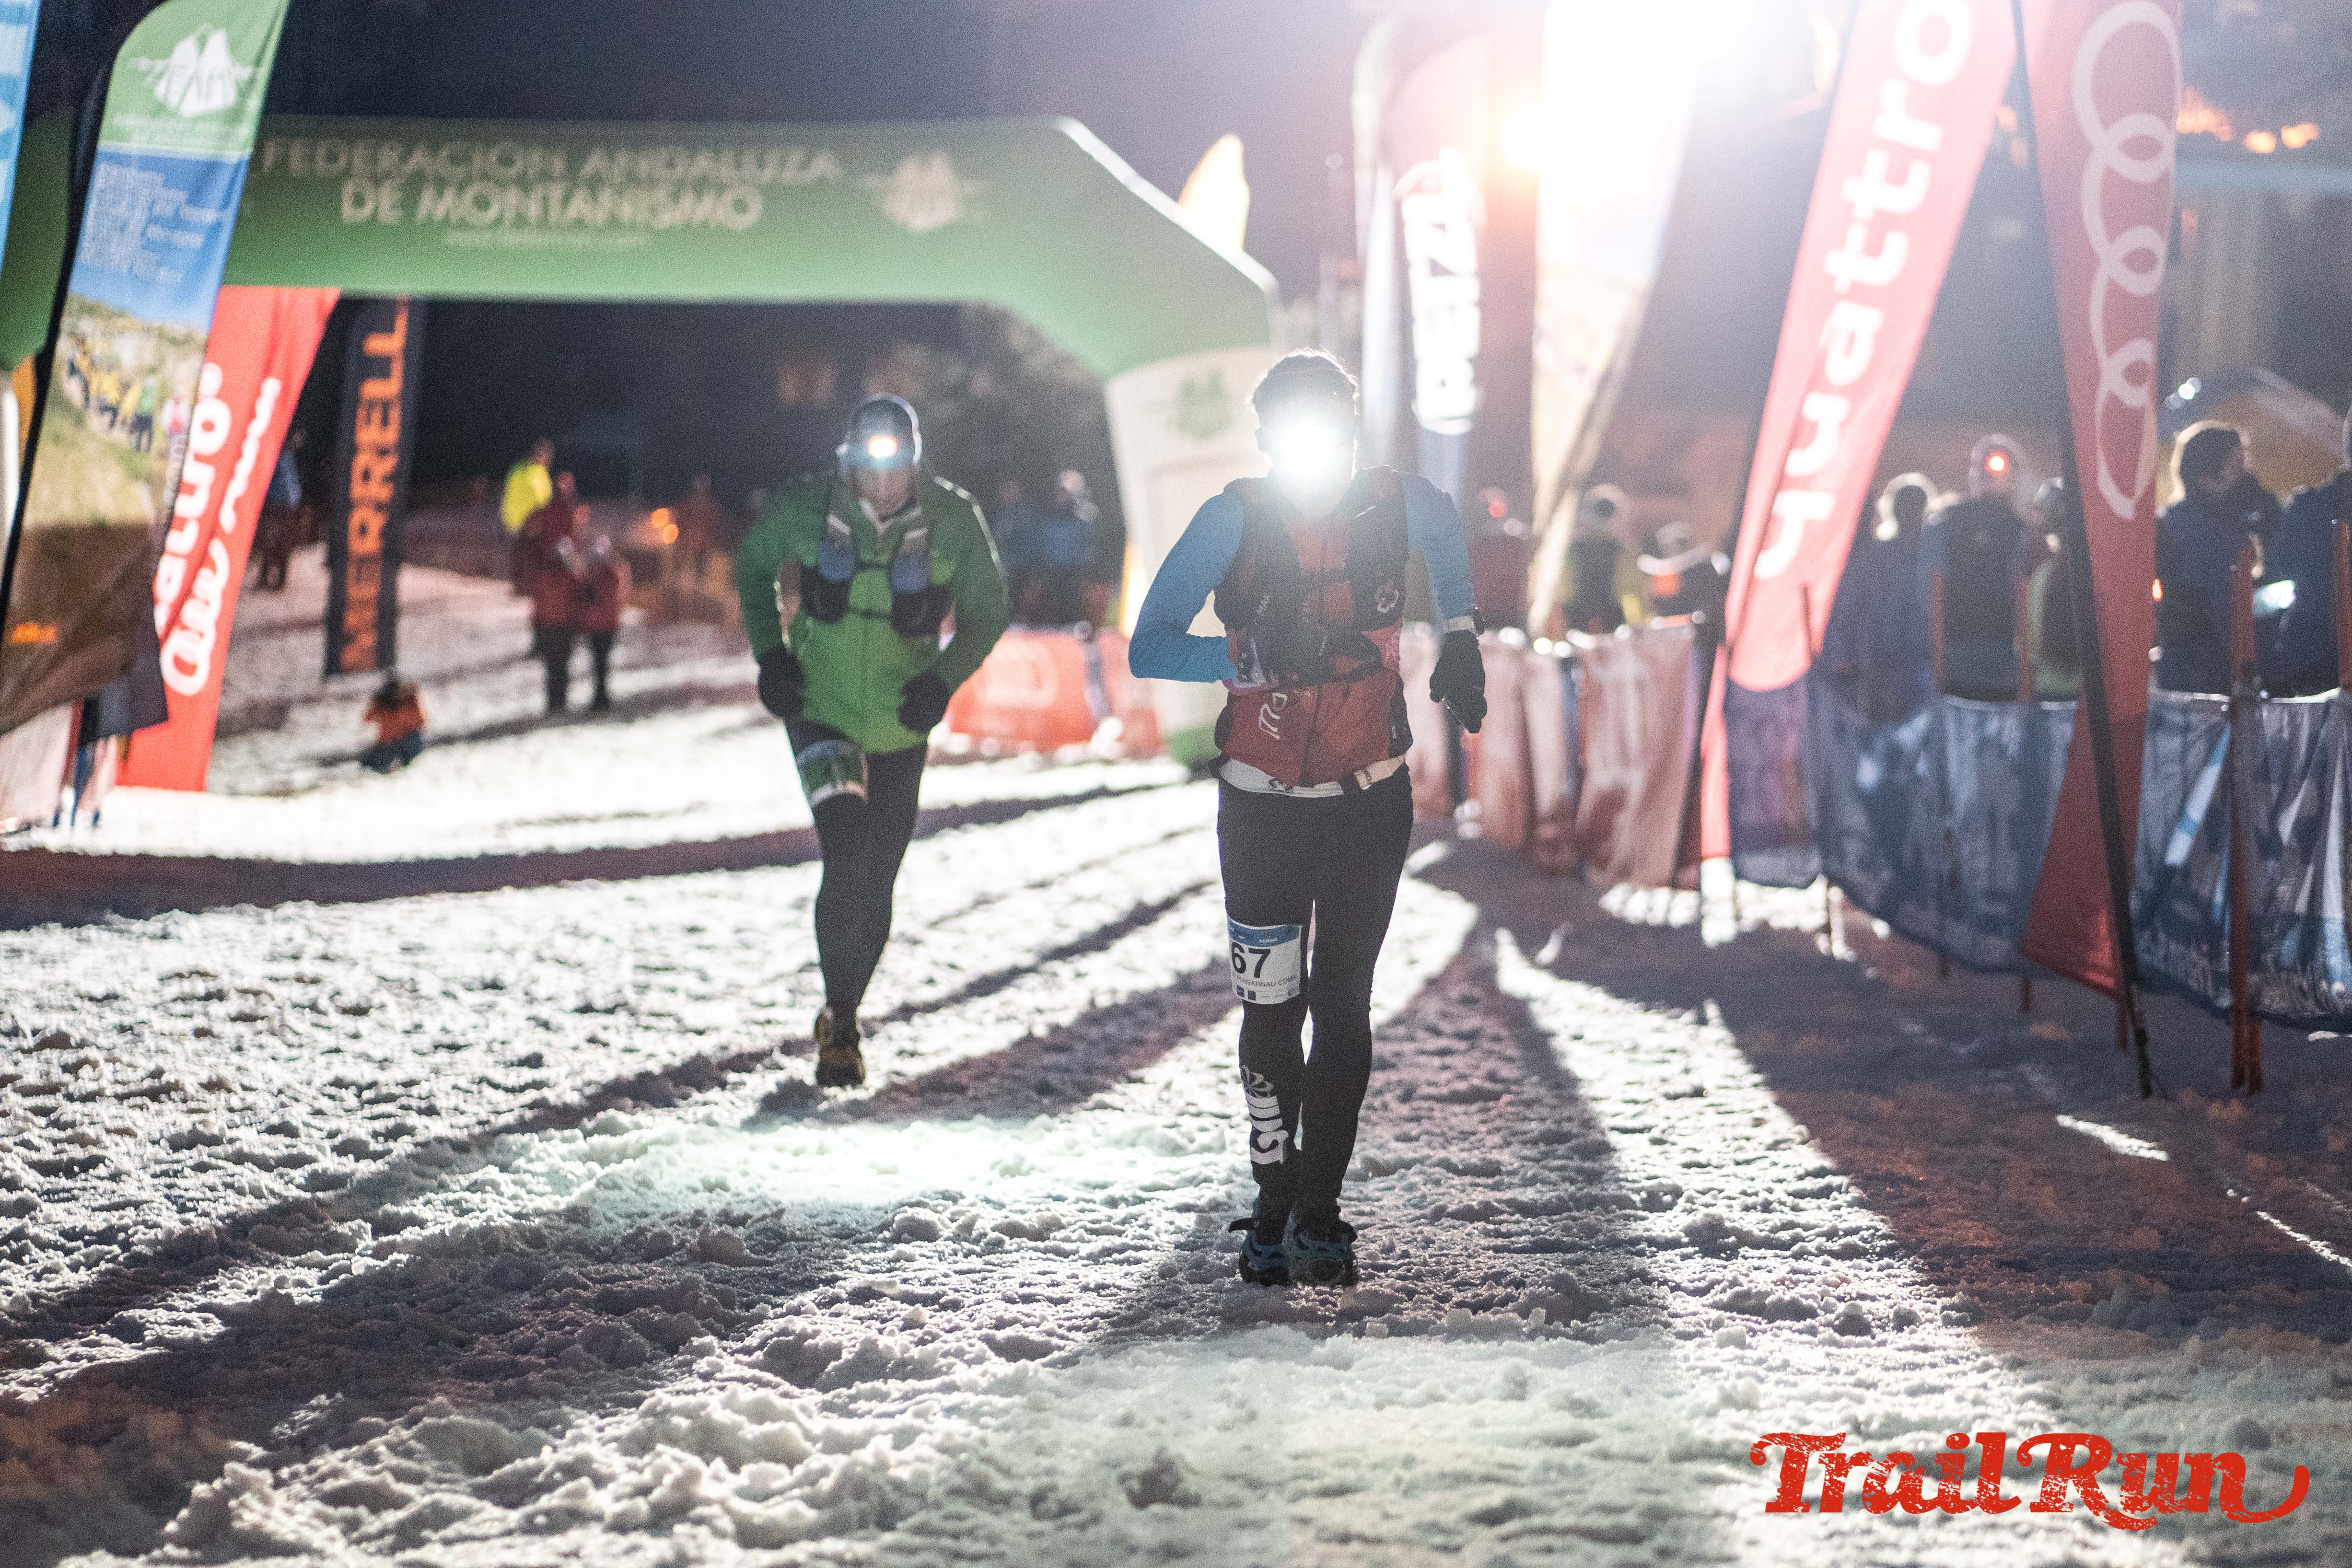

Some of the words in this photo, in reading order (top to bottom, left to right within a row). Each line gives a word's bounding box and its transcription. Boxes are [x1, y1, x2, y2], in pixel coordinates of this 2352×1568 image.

[577, 146, 843, 185] ANDALUZA
[340, 176, 402, 224] DE
[340, 294, 409, 672] MERRELL
[1231, 941, 1271, 978] 67
